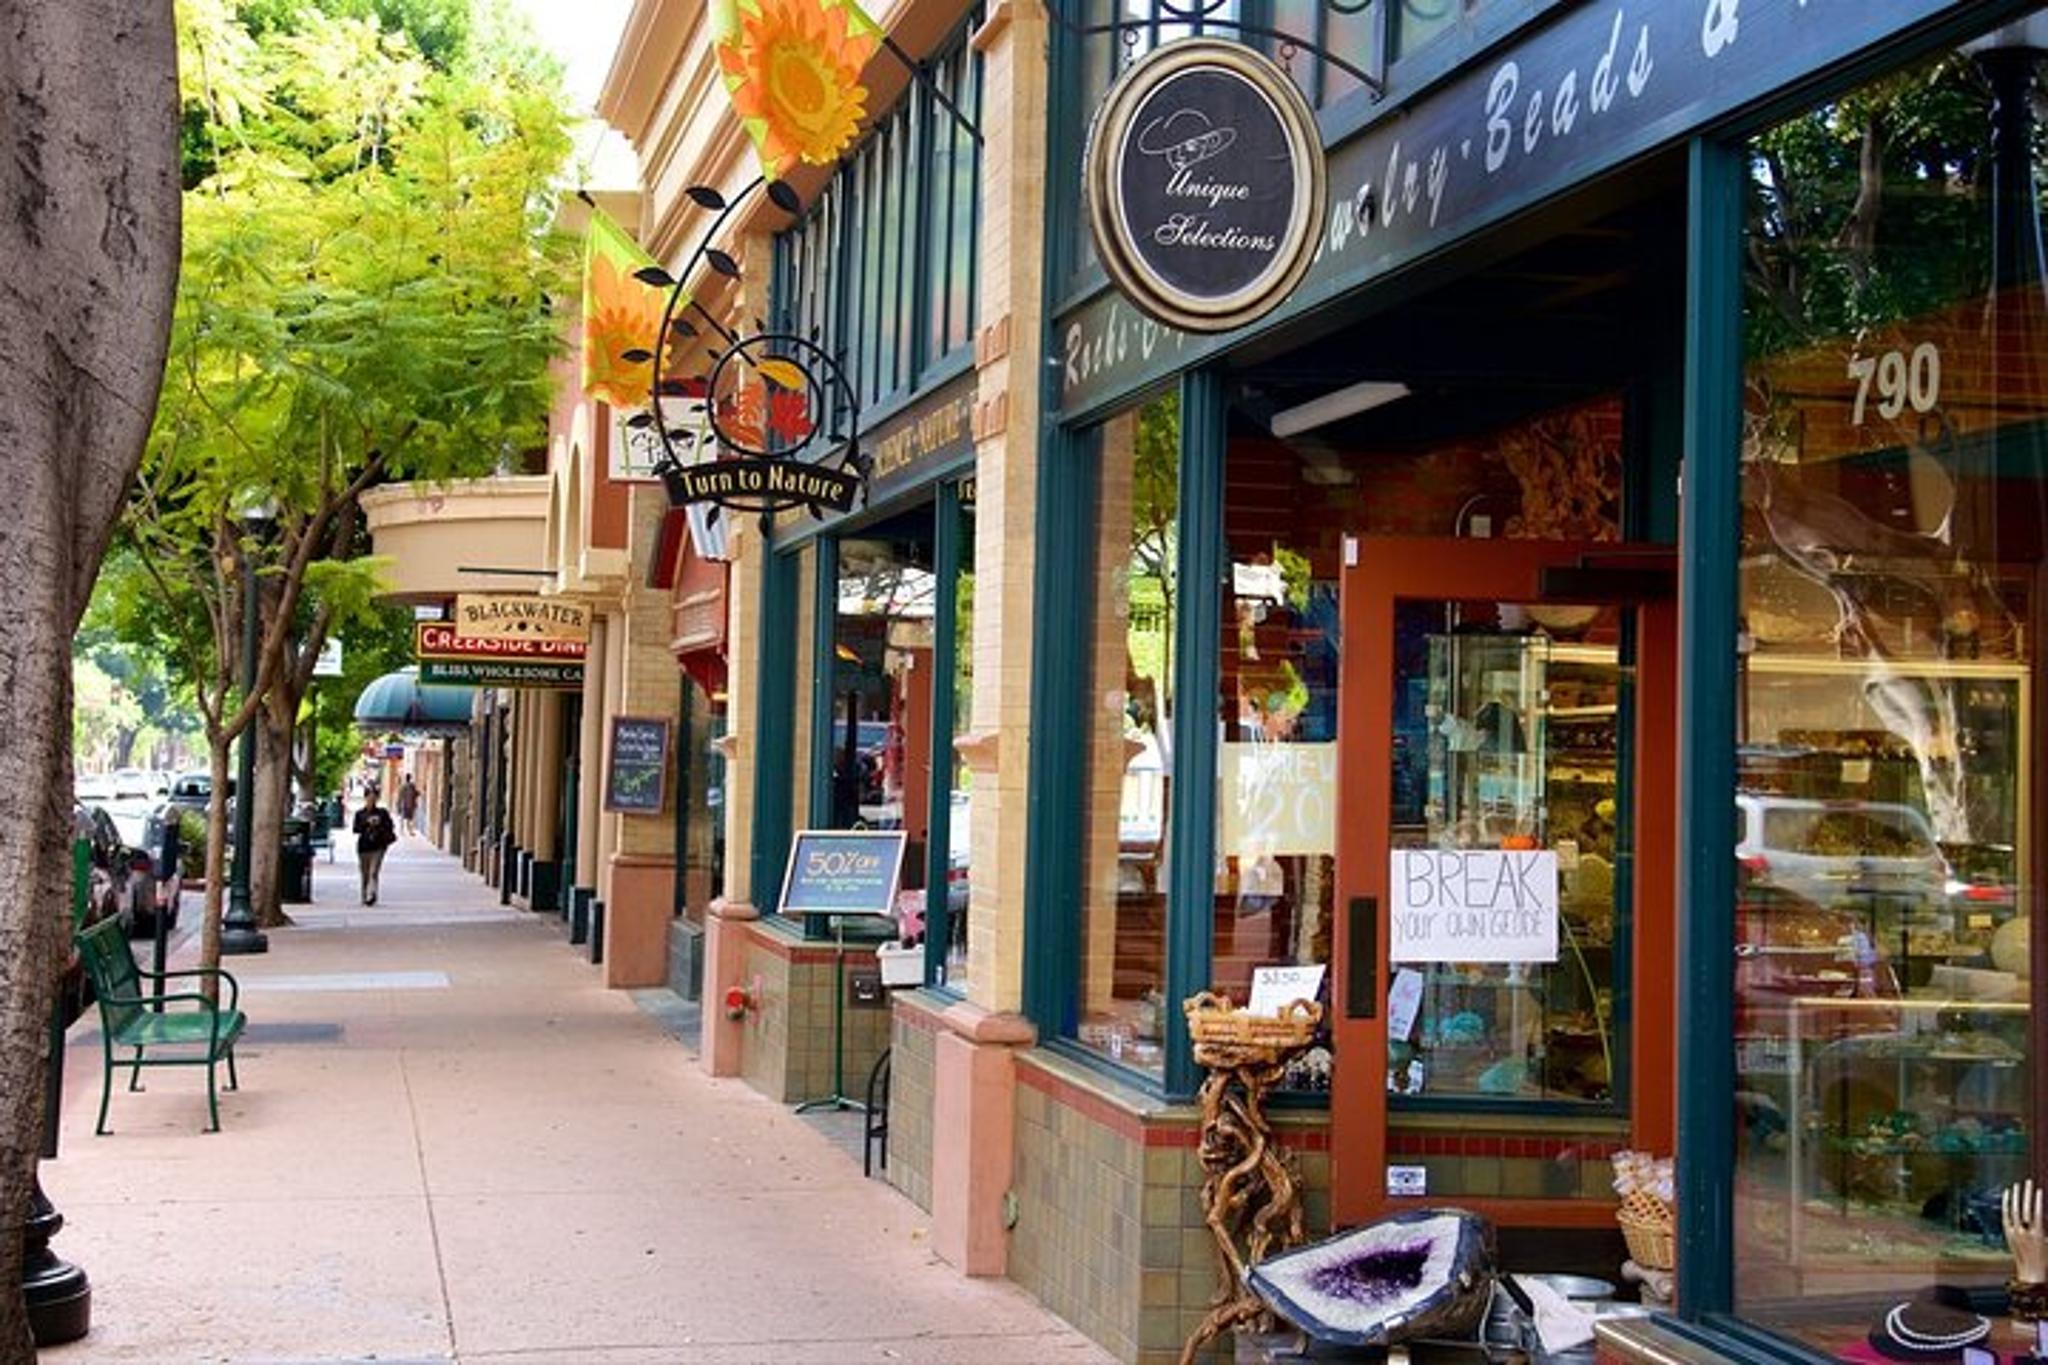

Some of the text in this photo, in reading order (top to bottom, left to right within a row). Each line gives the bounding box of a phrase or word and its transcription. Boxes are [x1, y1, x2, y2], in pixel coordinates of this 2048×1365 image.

[1485, 8, 1653, 173] Beads
[1166, 168, 1249, 208] Unique
[1154, 213, 1275, 251] Selections
[1847, 342, 1940, 426] 790
[680, 465, 843, 500] Turn to Nature
[464, 601, 584, 627] BLACKWATER
[1405, 852, 1543, 908] BREAK
[1447, 910, 1486, 938] OWN
